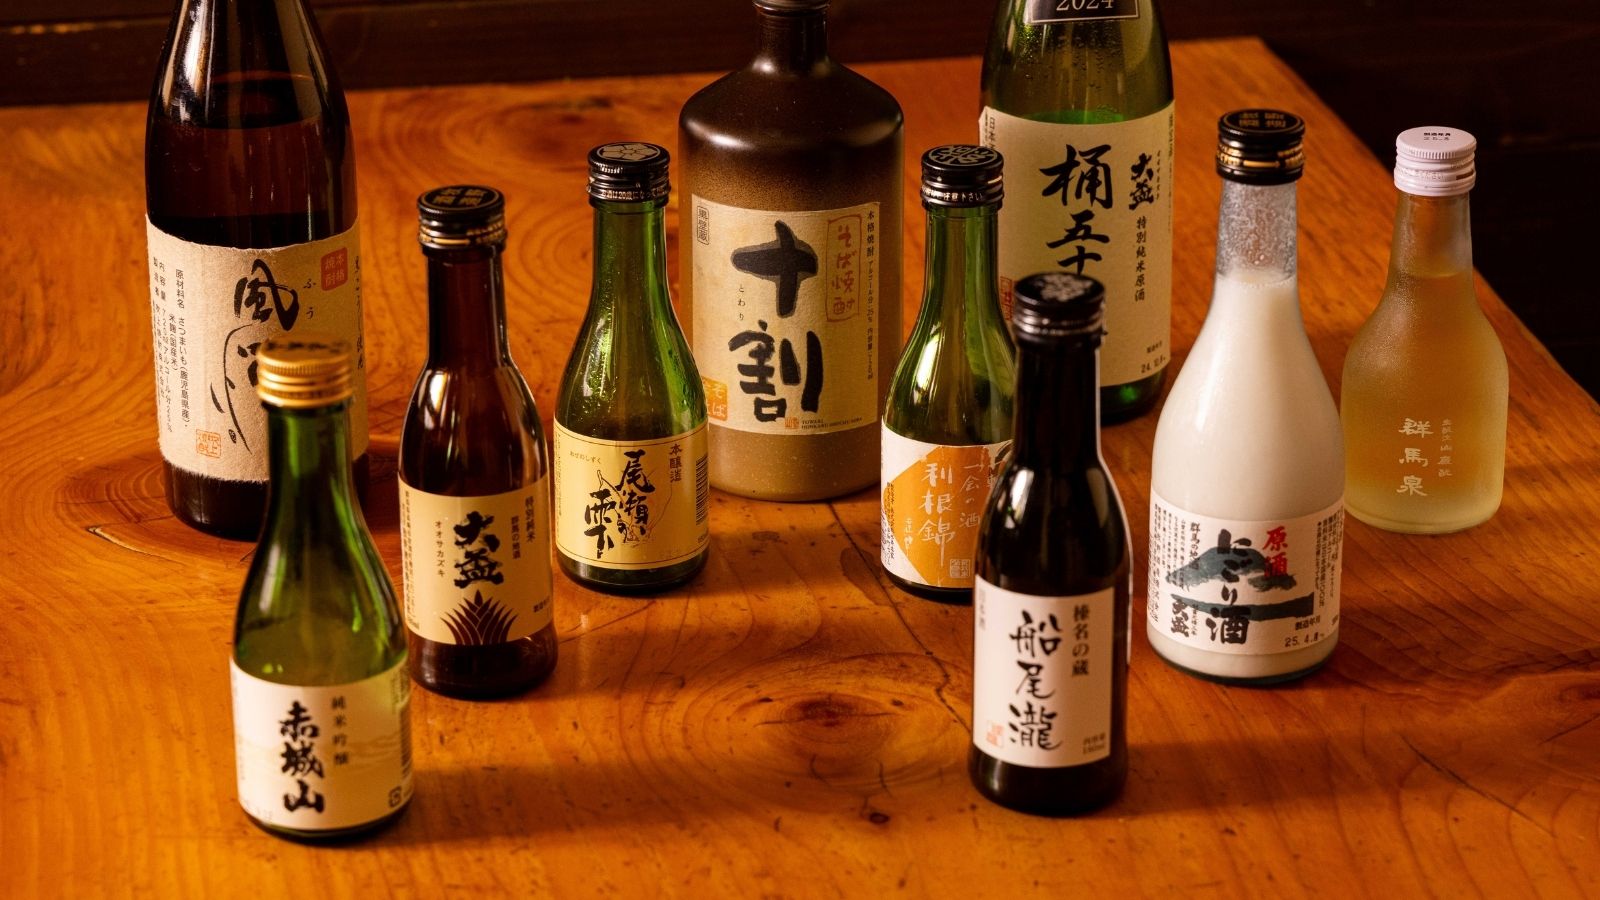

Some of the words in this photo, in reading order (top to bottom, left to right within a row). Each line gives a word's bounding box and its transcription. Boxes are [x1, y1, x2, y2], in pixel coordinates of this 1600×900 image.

[1056, 0, 1114, 12] 2024
[866, 210, 875, 257] 本格焼酎
[1040, 144, 1113, 275] 桶五十
[831, 225, 858, 315] そば焼酎
[1135, 216, 1147, 302] 特別純米原酒
[729, 219, 824, 422] 十割
[737, 284, 746, 321] とわり
[669, 443, 682, 483] 本醸造
[1397, 418, 1434, 496] 群馬泉
[435, 521, 445, 577] オオサカズキ
[453, 511, 504, 589] 大盃
[525, 496, 535, 542] 特別純米
[918, 462, 955, 568] 利根錦
[1263, 526, 1288, 578] 原酒
[1205, 529, 1254, 644] にごり酒
[1071, 604, 1090, 677] 榛名の蔵
[1009, 610, 1063, 751] 船尾瀧
[279, 701, 325, 813] 赤城山
[332, 696, 349, 766] 純米吟醸
